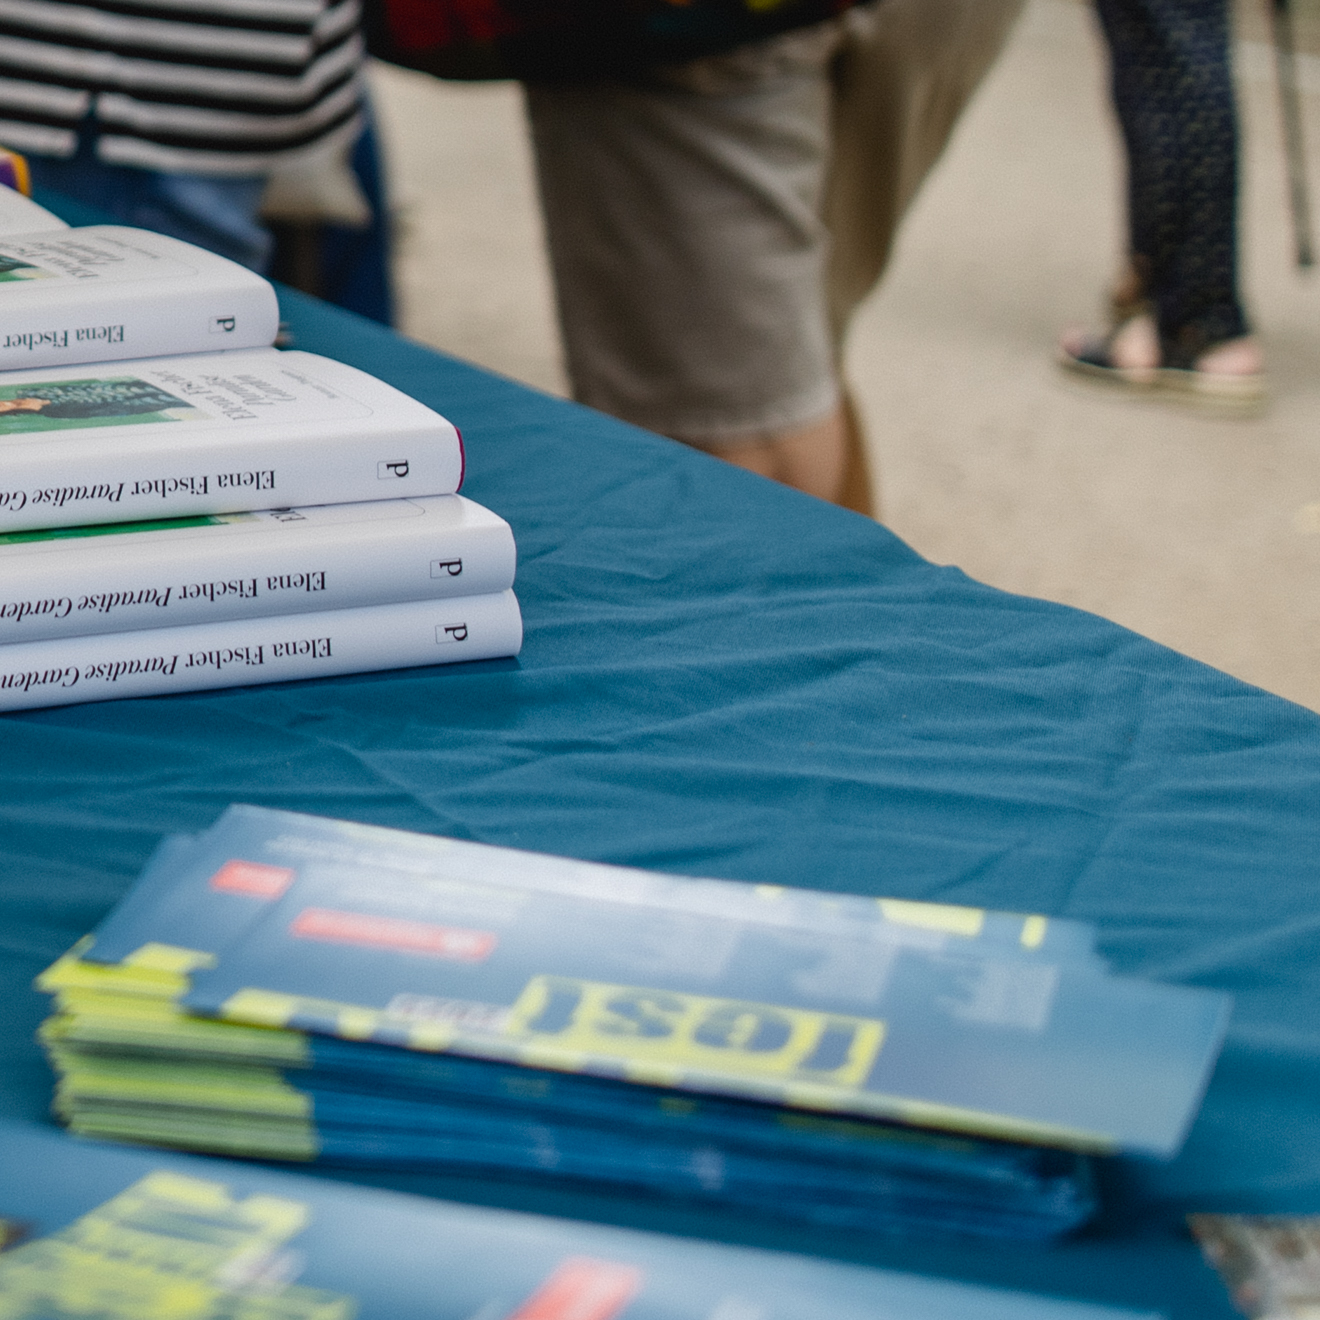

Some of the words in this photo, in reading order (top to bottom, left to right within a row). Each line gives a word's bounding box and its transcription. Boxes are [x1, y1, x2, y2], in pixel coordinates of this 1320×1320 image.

[4, 330, 69, 349] Fischer
[76, 325, 125, 342] Elena
[131, 475, 209, 497] Fischer
[218, 470, 276, 489] Elena
[32, 482, 125, 509] Paradise
[179, 578, 258, 602] Fischer
[267, 572, 327, 591] Elena
[78, 586, 172, 613] Paradise
[184, 645, 264, 669] Fischer
[272, 638, 332, 658] Elena
[1, 667, 80, 689] Garden
[85, 654, 178, 681] Paradise
